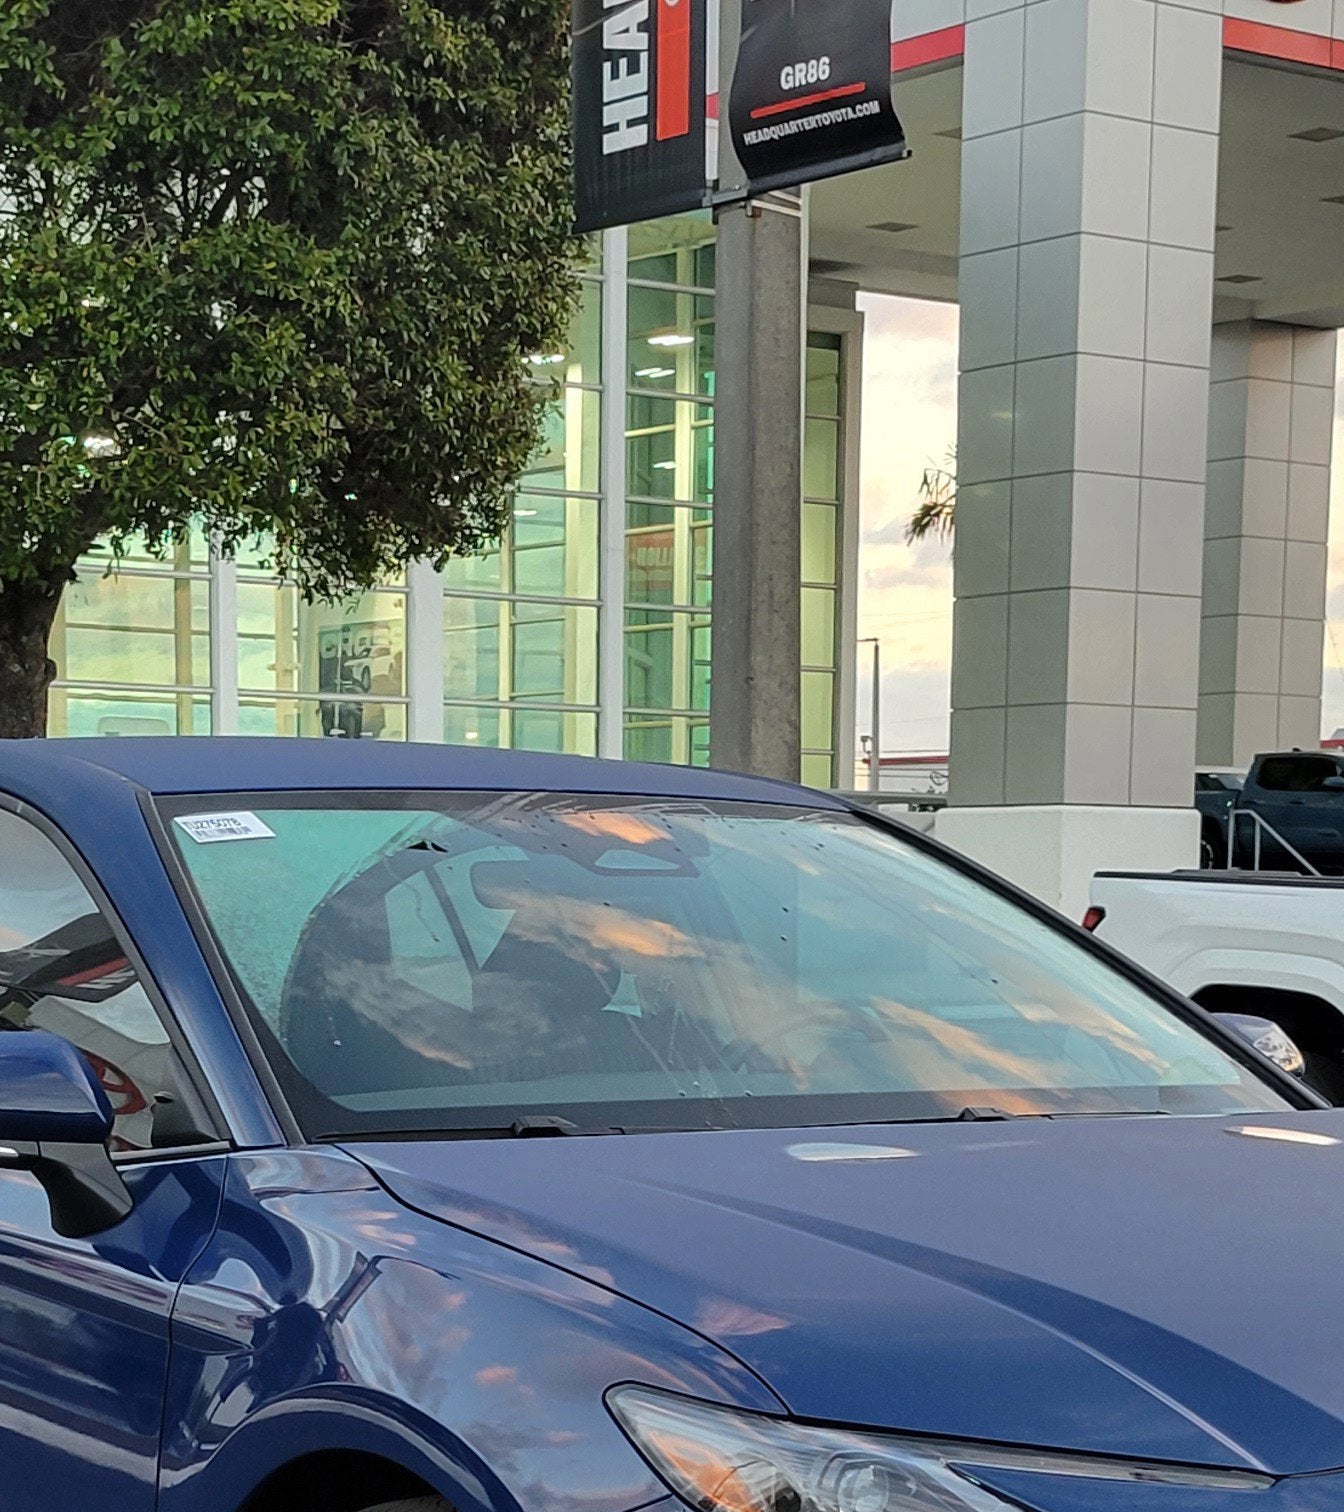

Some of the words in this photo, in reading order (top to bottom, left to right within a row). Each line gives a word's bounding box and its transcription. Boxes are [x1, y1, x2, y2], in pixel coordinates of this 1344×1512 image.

[602, 0, 649, 155] HEA
[780, 56, 830, 90] GR86
[743, 100, 881, 146] HEADQUARTERTOYOTA.COM
